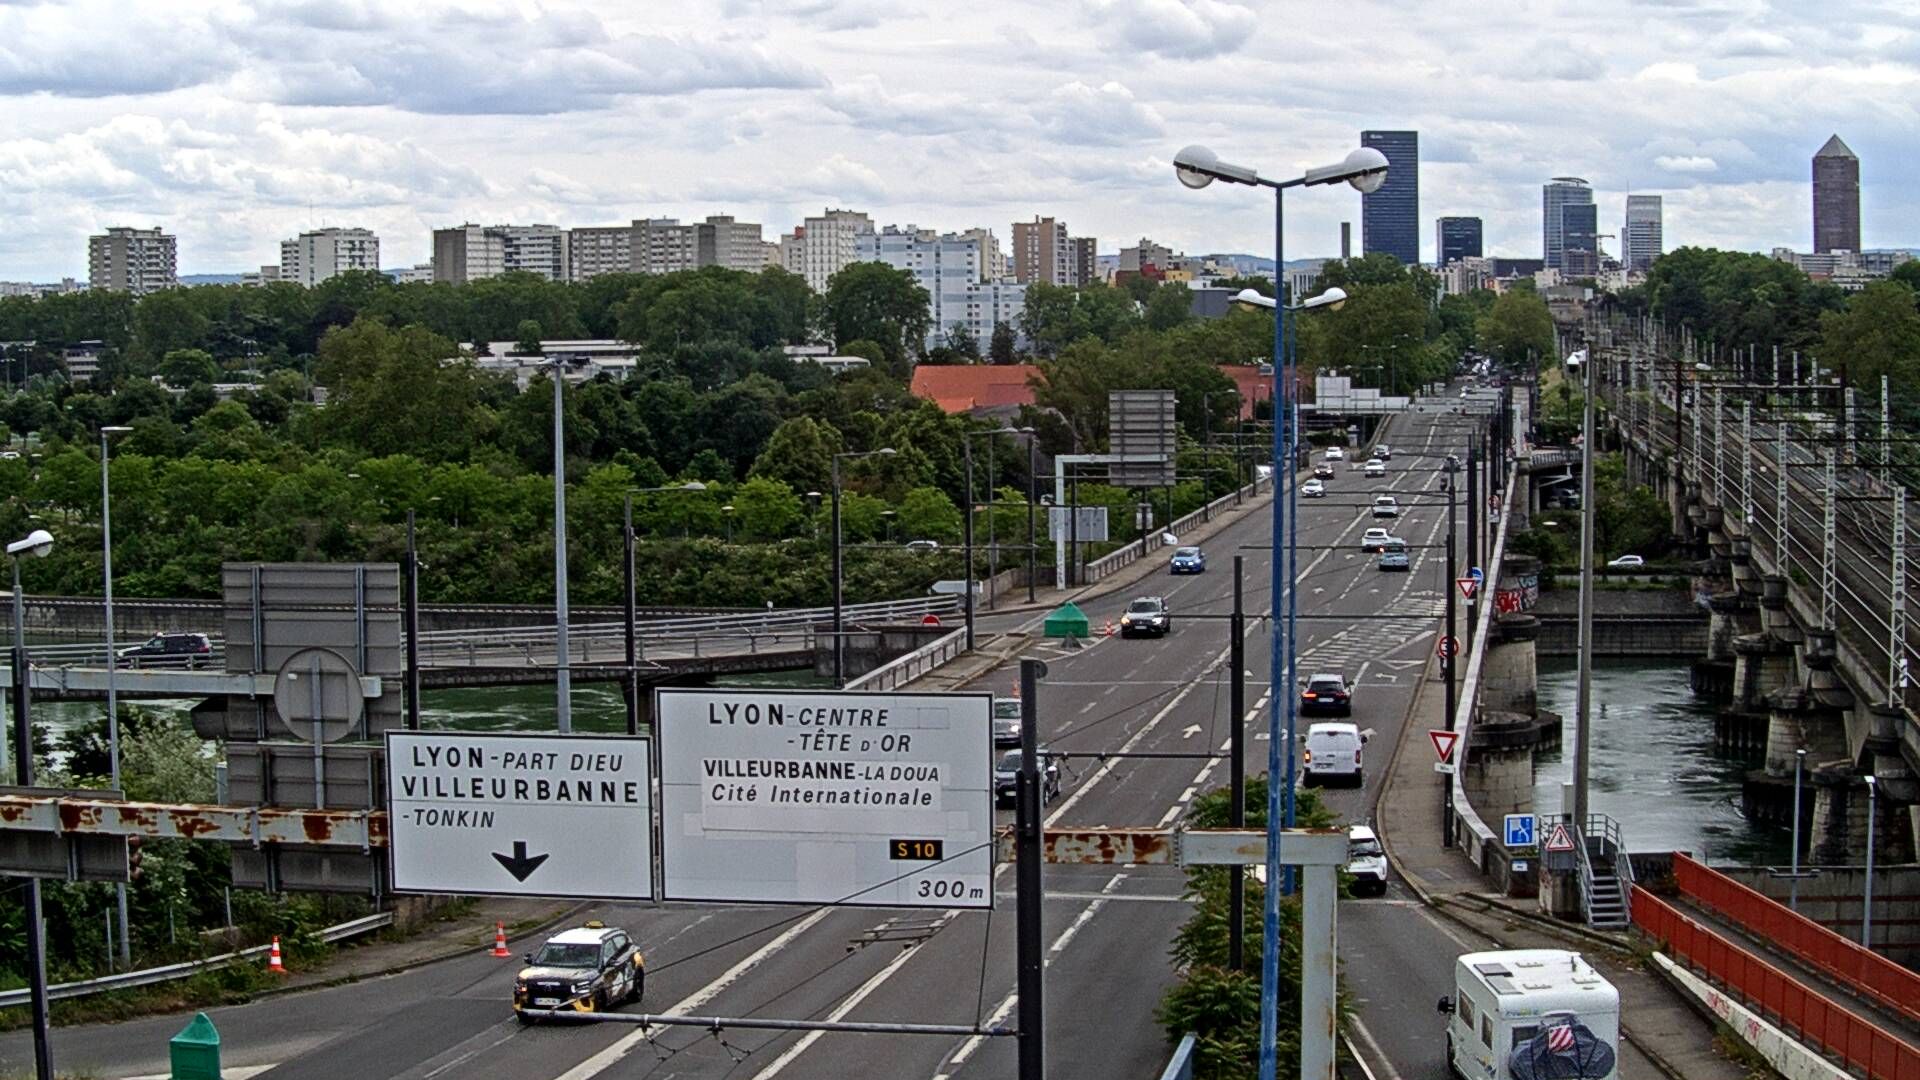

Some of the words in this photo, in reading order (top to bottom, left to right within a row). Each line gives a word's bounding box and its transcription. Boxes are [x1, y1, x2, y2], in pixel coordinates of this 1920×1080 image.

[570, 754, 623, 771] DIEU
[890, 766, 939, 781] DOUA
[402, 776, 639, 803] VILLEURBANNE
[711, 784, 757, 801] Cité
[770, 785, 932, 806] Internationale
[898, 842, 908, 857] S
[914, 842, 935, 858] 10
[918, 880, 965, 898] 300
[969, 888, 984, 899] m
